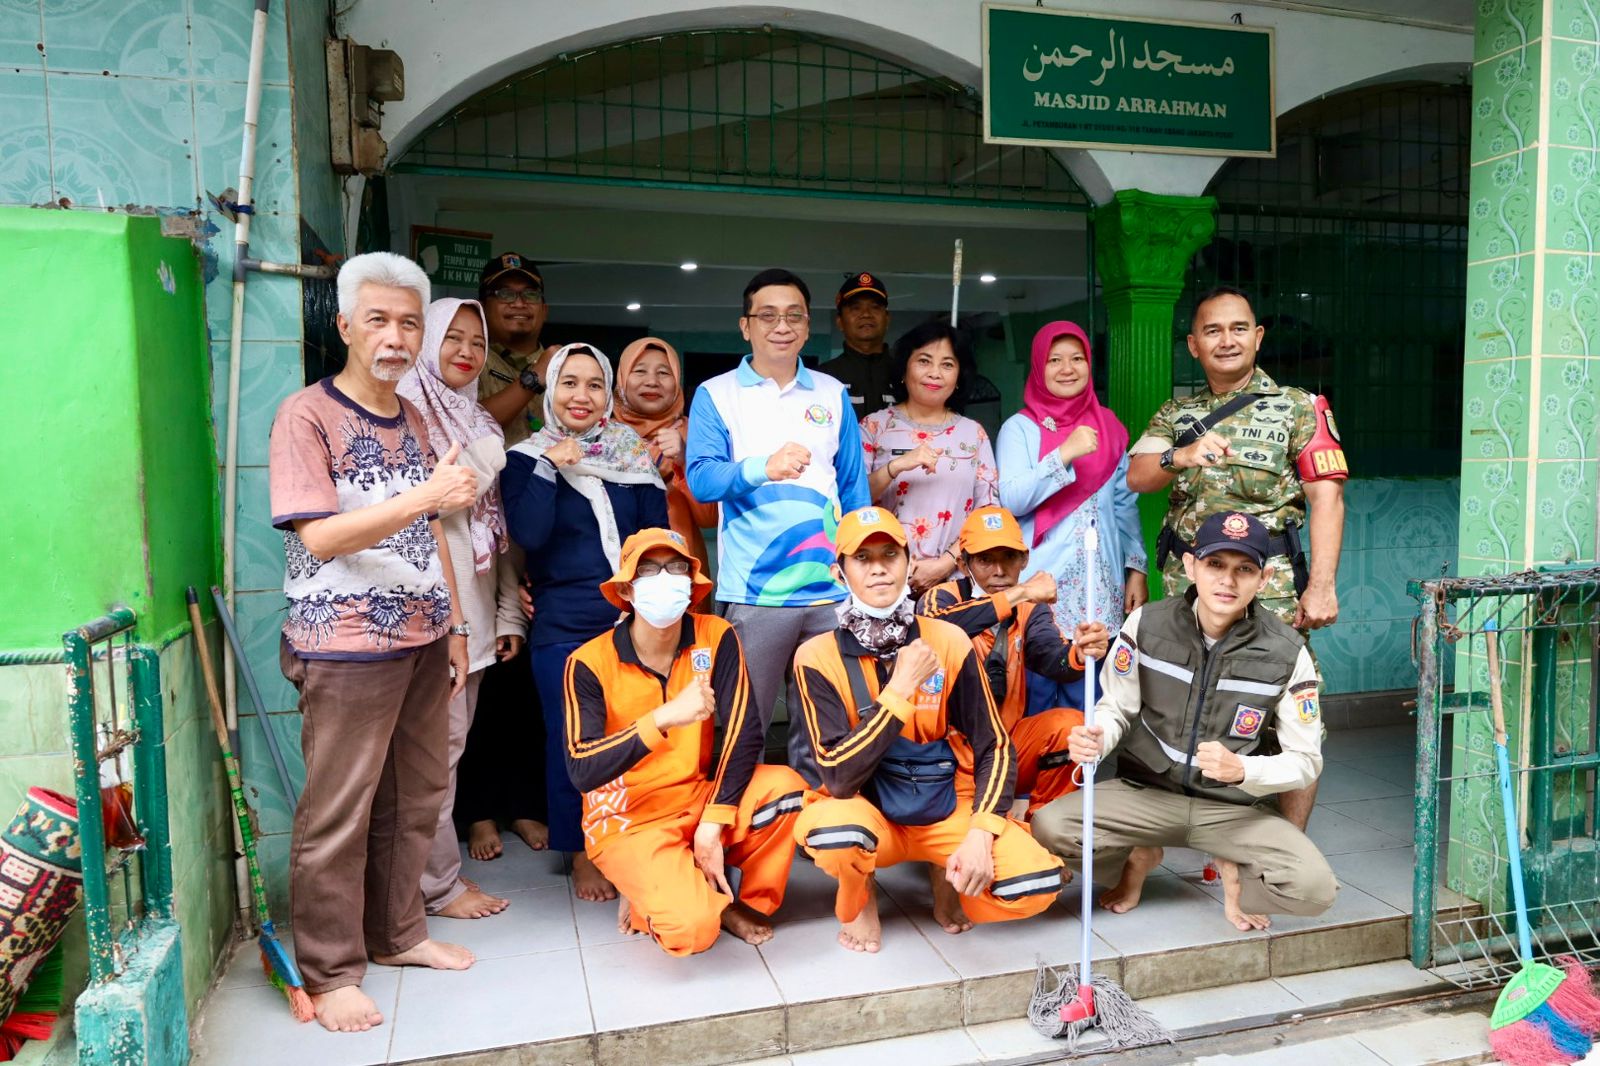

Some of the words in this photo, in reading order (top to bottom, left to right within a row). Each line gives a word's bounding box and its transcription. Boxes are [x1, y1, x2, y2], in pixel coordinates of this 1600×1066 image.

[1022, 28, 1126, 86] الرحمن
[1132, 39, 1235, 78] مسجد
[1034, 91, 1110, 111] MASJID
[1116, 96, 1227, 118] ARRAHMAN
[454, 243, 473, 255] TOILET
[443, 255, 466, 267] TEMPAT
[443, 270, 480, 284] IKHWA
[1241, 427, 1262, 440] TNI
[1266, 431, 1286, 443] AD
